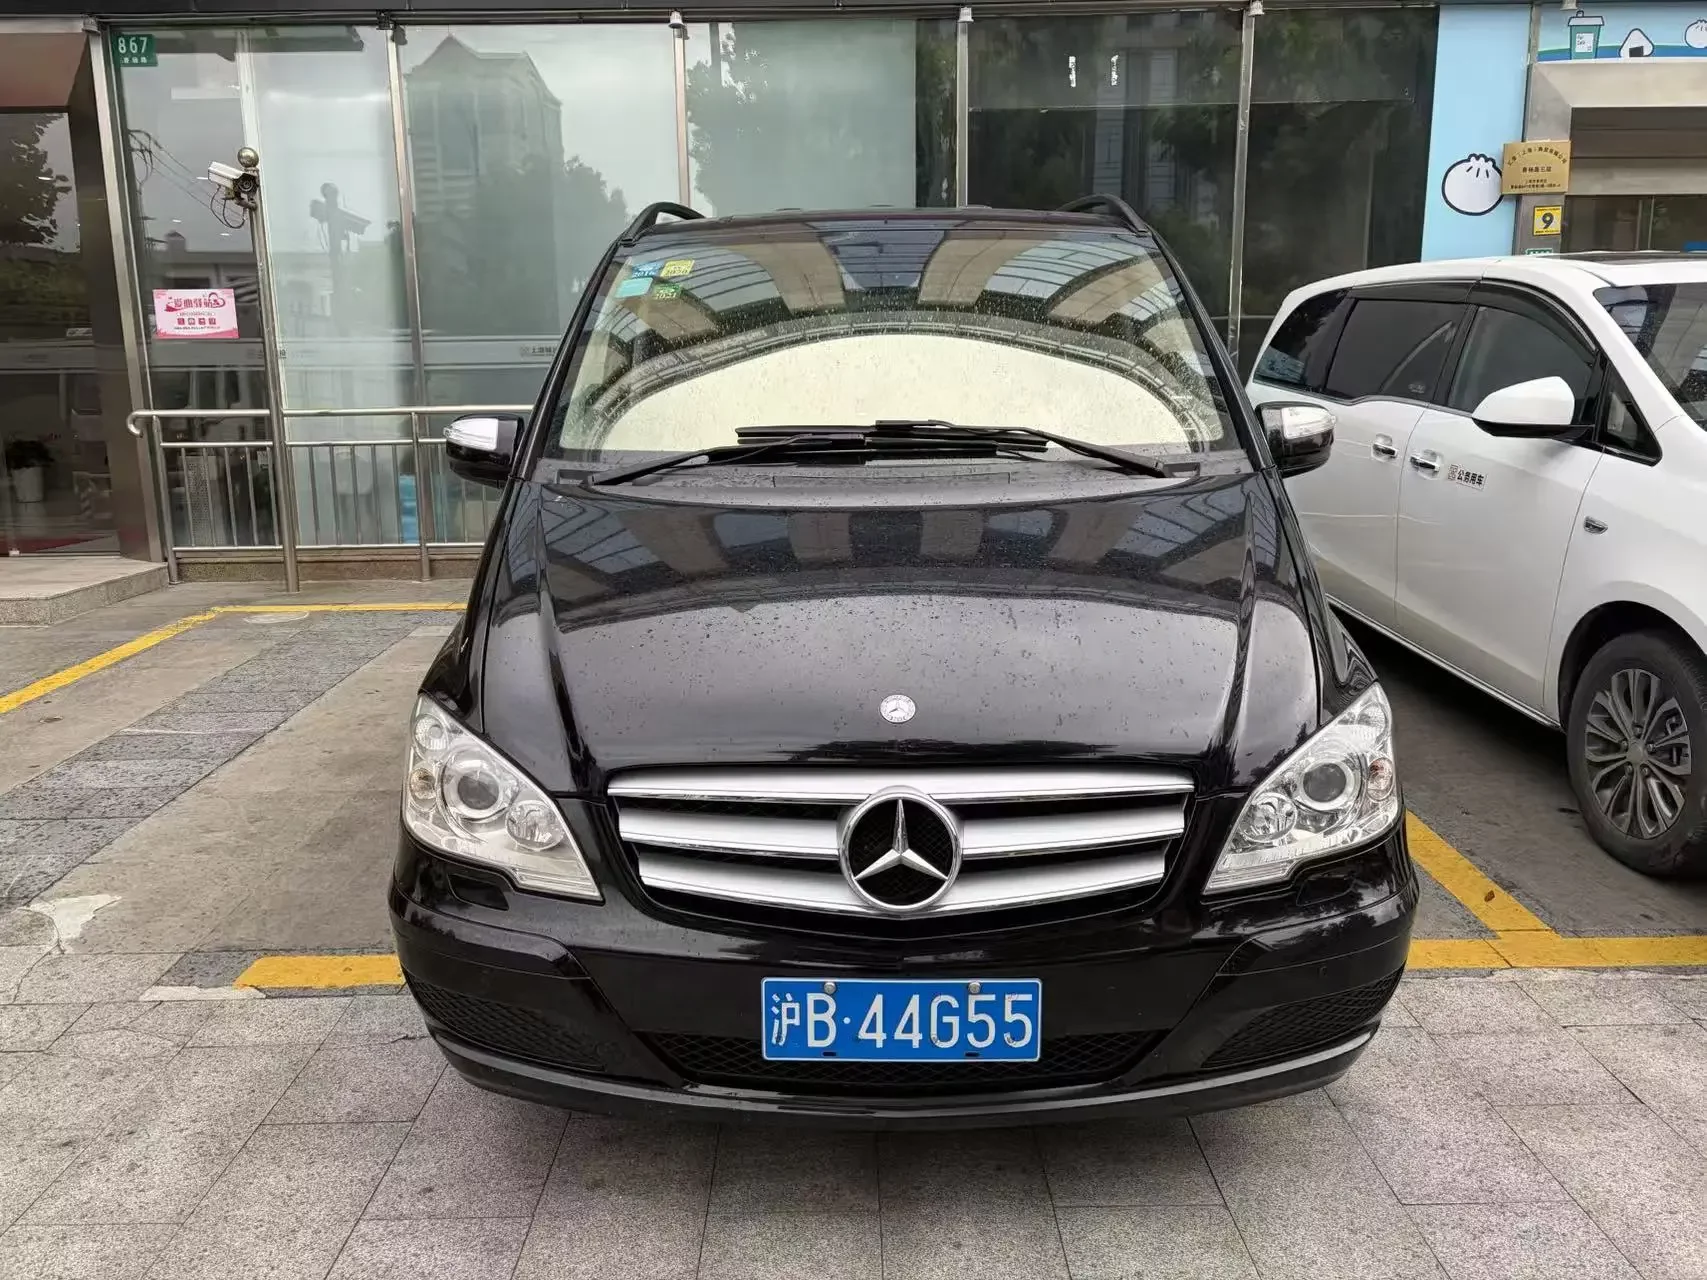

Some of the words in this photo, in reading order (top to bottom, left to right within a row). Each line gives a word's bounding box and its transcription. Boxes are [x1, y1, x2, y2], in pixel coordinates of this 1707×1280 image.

[118, 36, 148, 54] 867
[1541, 212, 1555, 230] 9
[771, 992, 1033, 1048] 沪B·44G55
